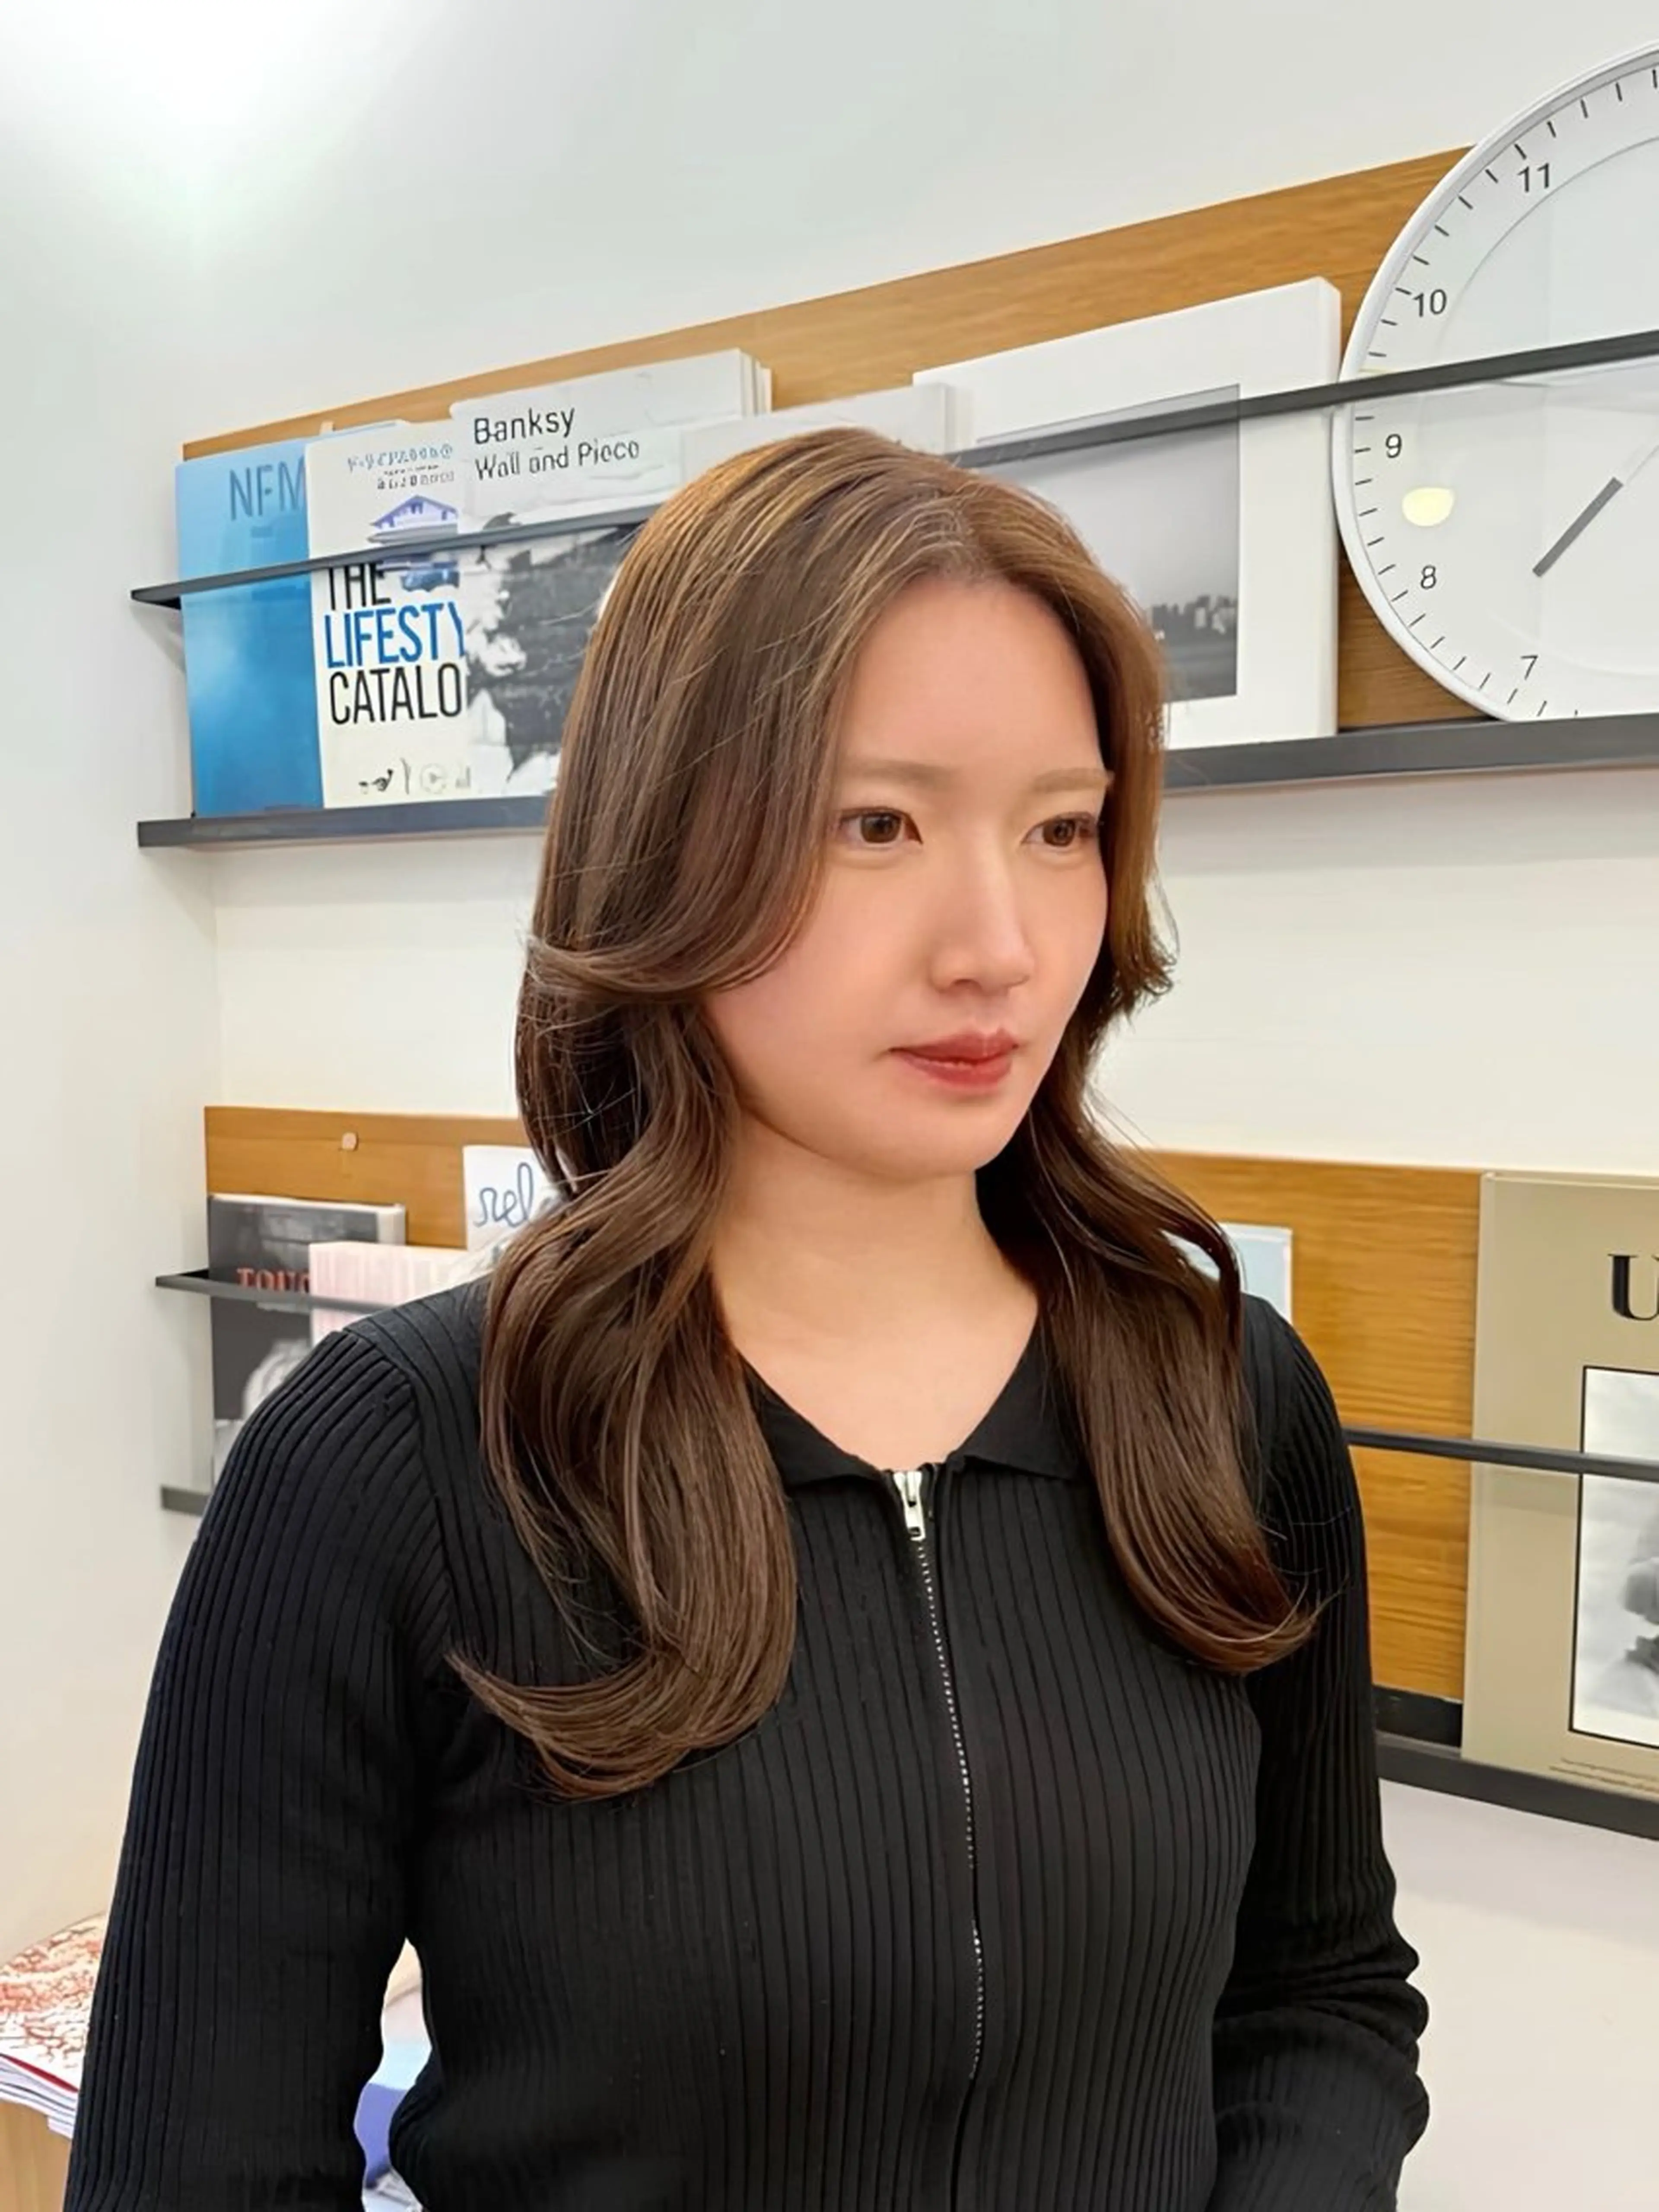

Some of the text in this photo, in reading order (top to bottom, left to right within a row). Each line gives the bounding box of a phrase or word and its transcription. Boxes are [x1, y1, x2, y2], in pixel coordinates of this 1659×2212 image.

[1518, 163, 1551, 192] 11
[1412, 289, 1448, 317] 10
[474, 407, 575, 445] Banksy
[1385, 433, 1402, 458] 9
[1420, 565, 1437, 590] 8
[1520, 655, 1538, 680] 7
[329, 662, 461, 725] CATALO
